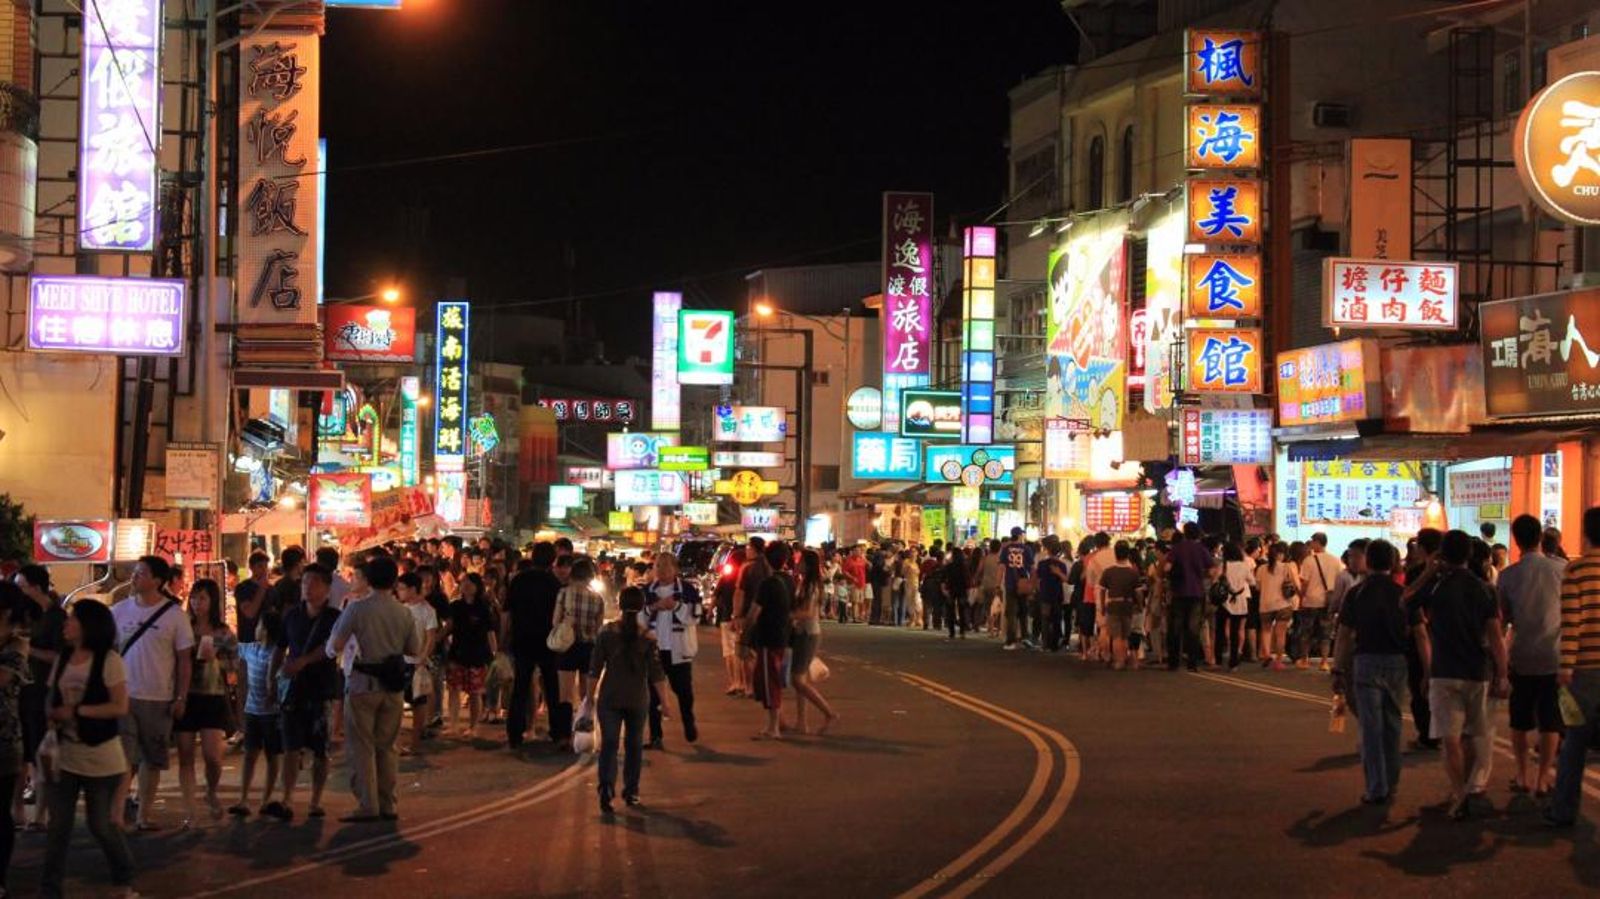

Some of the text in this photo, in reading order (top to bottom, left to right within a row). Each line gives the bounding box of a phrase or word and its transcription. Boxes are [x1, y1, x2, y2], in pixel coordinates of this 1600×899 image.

[248, 41, 309, 310] 海悅飯店
[1197, 38, 1253, 386] 楓海美食館
[1341, 266, 1448, 296] 擔仔麵
[126, 286, 178, 315] HOTEL
[1341, 296, 1448, 324] 滷肉飯
[856, 437, 918, 473] 藥局
